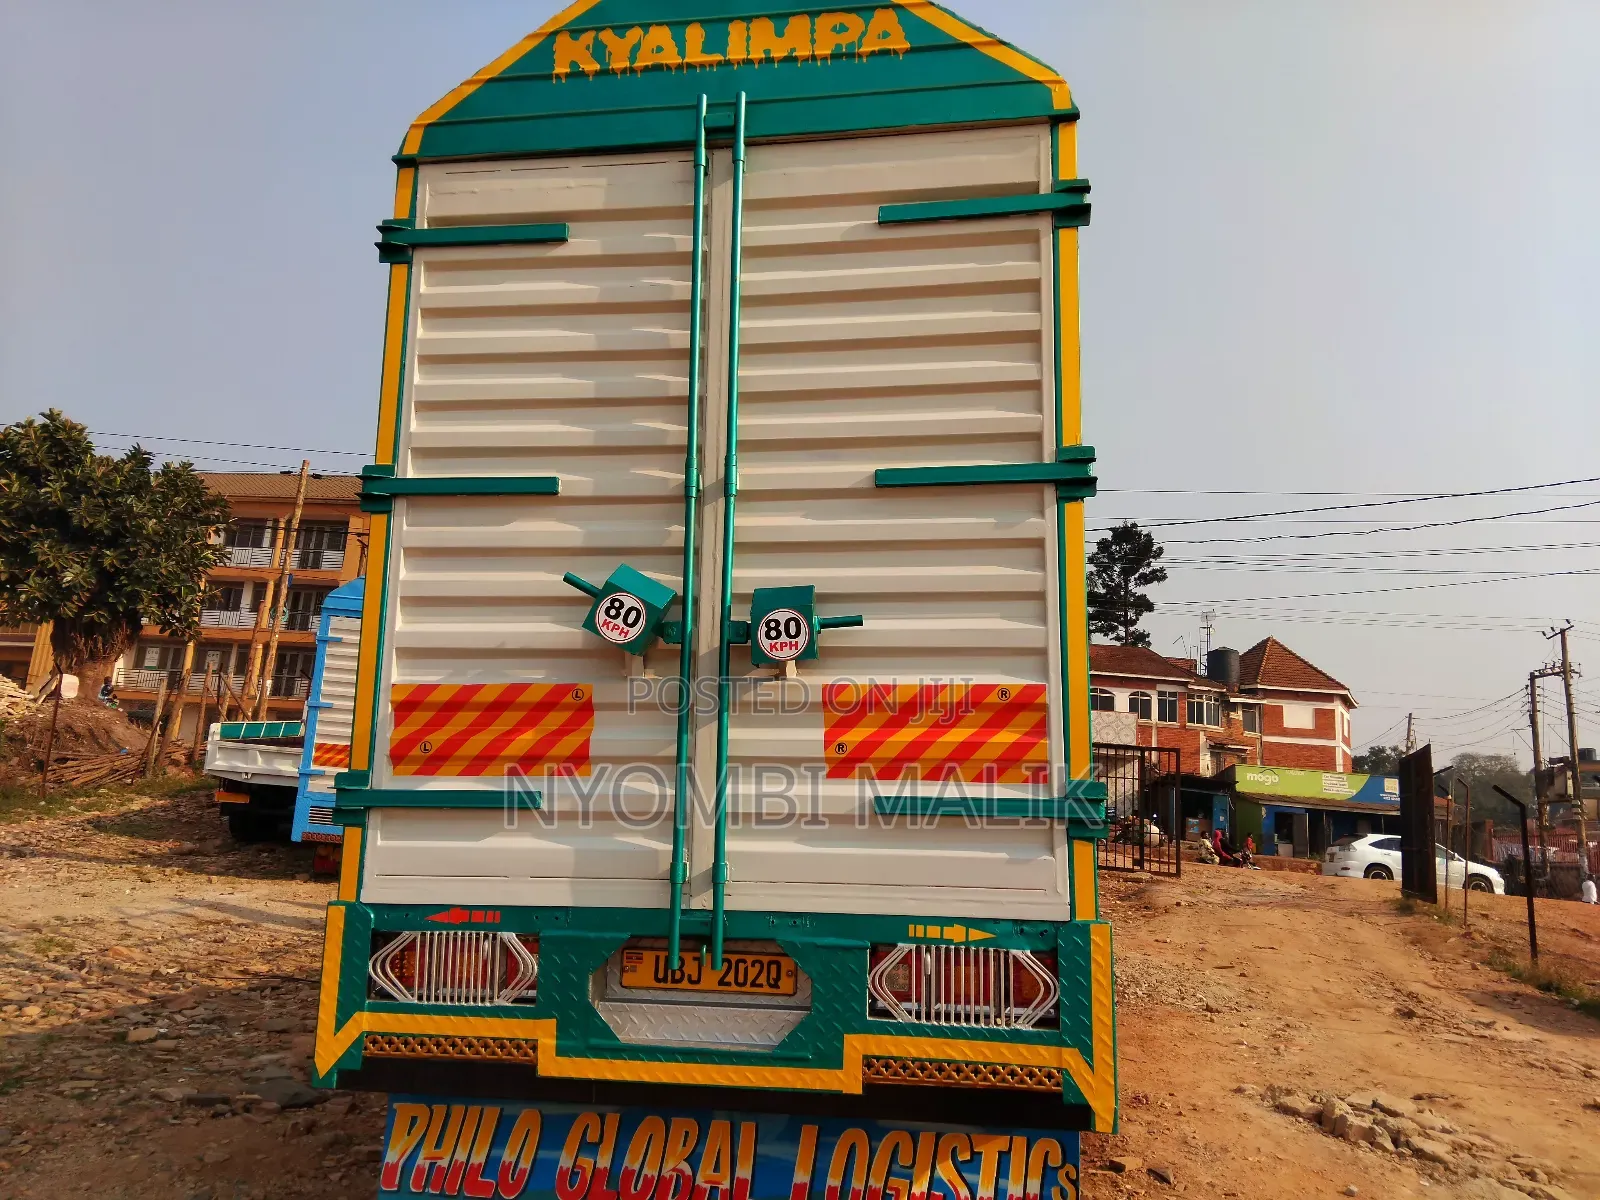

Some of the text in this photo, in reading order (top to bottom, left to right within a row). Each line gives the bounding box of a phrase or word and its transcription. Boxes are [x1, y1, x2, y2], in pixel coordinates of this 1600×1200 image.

[552, 8, 911, 84] KYALIMPA
[604, 598, 641, 628] 80
[601, 619, 629, 638] KPH
[765, 617, 801, 640] 80
[769, 641, 799, 652] KPH
[1246, 772, 1279, 786] mogo
[654, 955, 782, 989] UBJ 202Q
[380, 1103, 541, 1199] PHILO
[555, 1111, 757, 1200] GLOBAL
